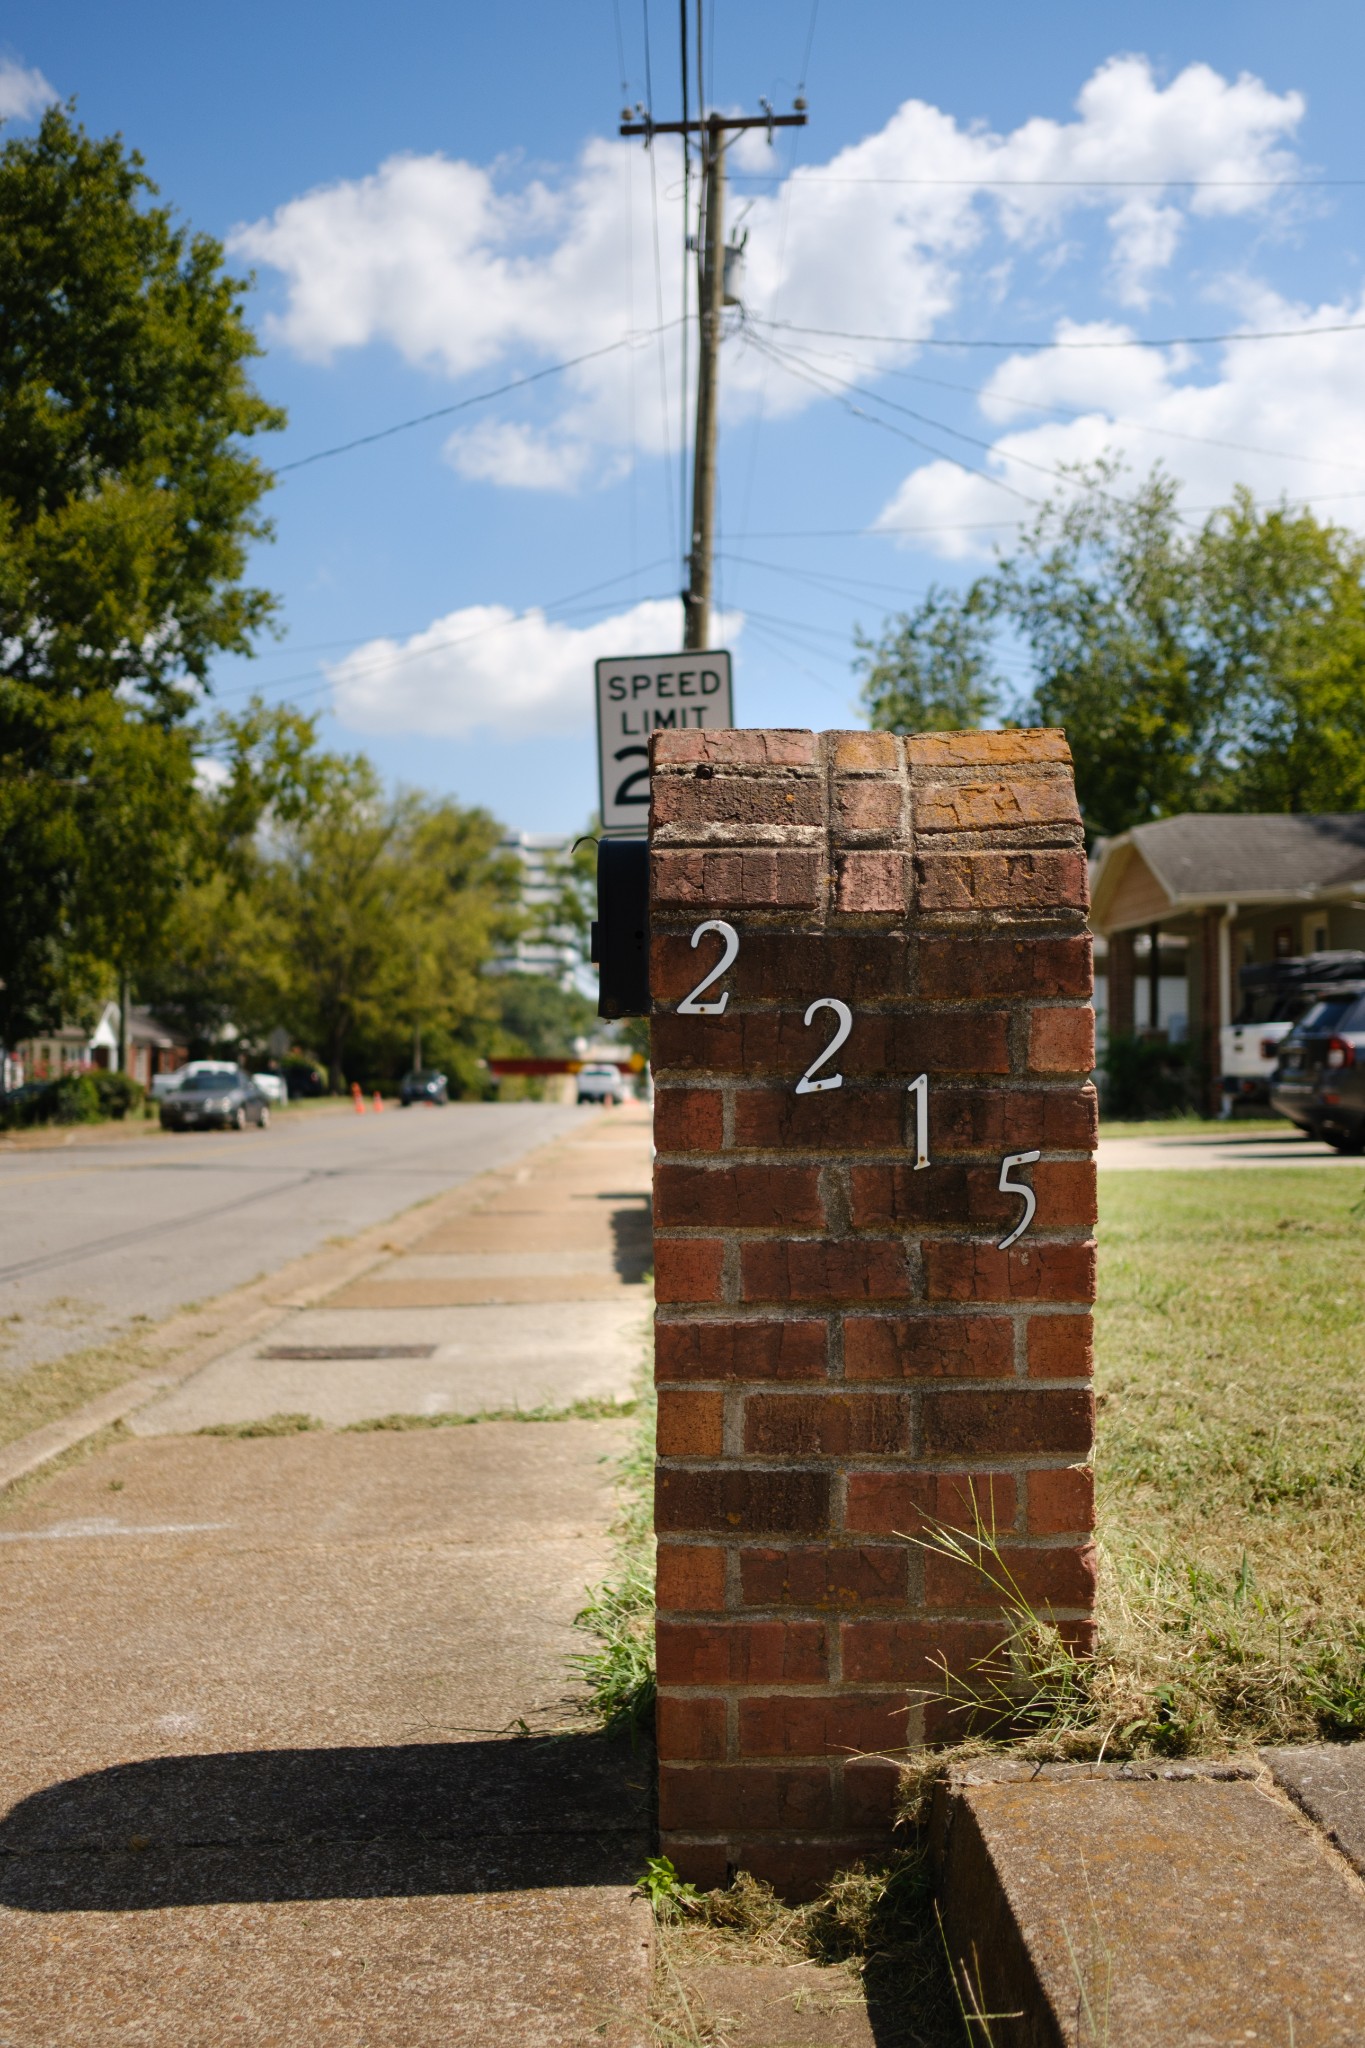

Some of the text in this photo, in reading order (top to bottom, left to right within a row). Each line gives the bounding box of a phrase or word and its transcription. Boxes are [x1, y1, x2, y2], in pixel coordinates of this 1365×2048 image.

[608, 671, 721, 701] SPEED
[622, 706, 708, 735] LIMIT
[613, 745, 650, 806] 2
